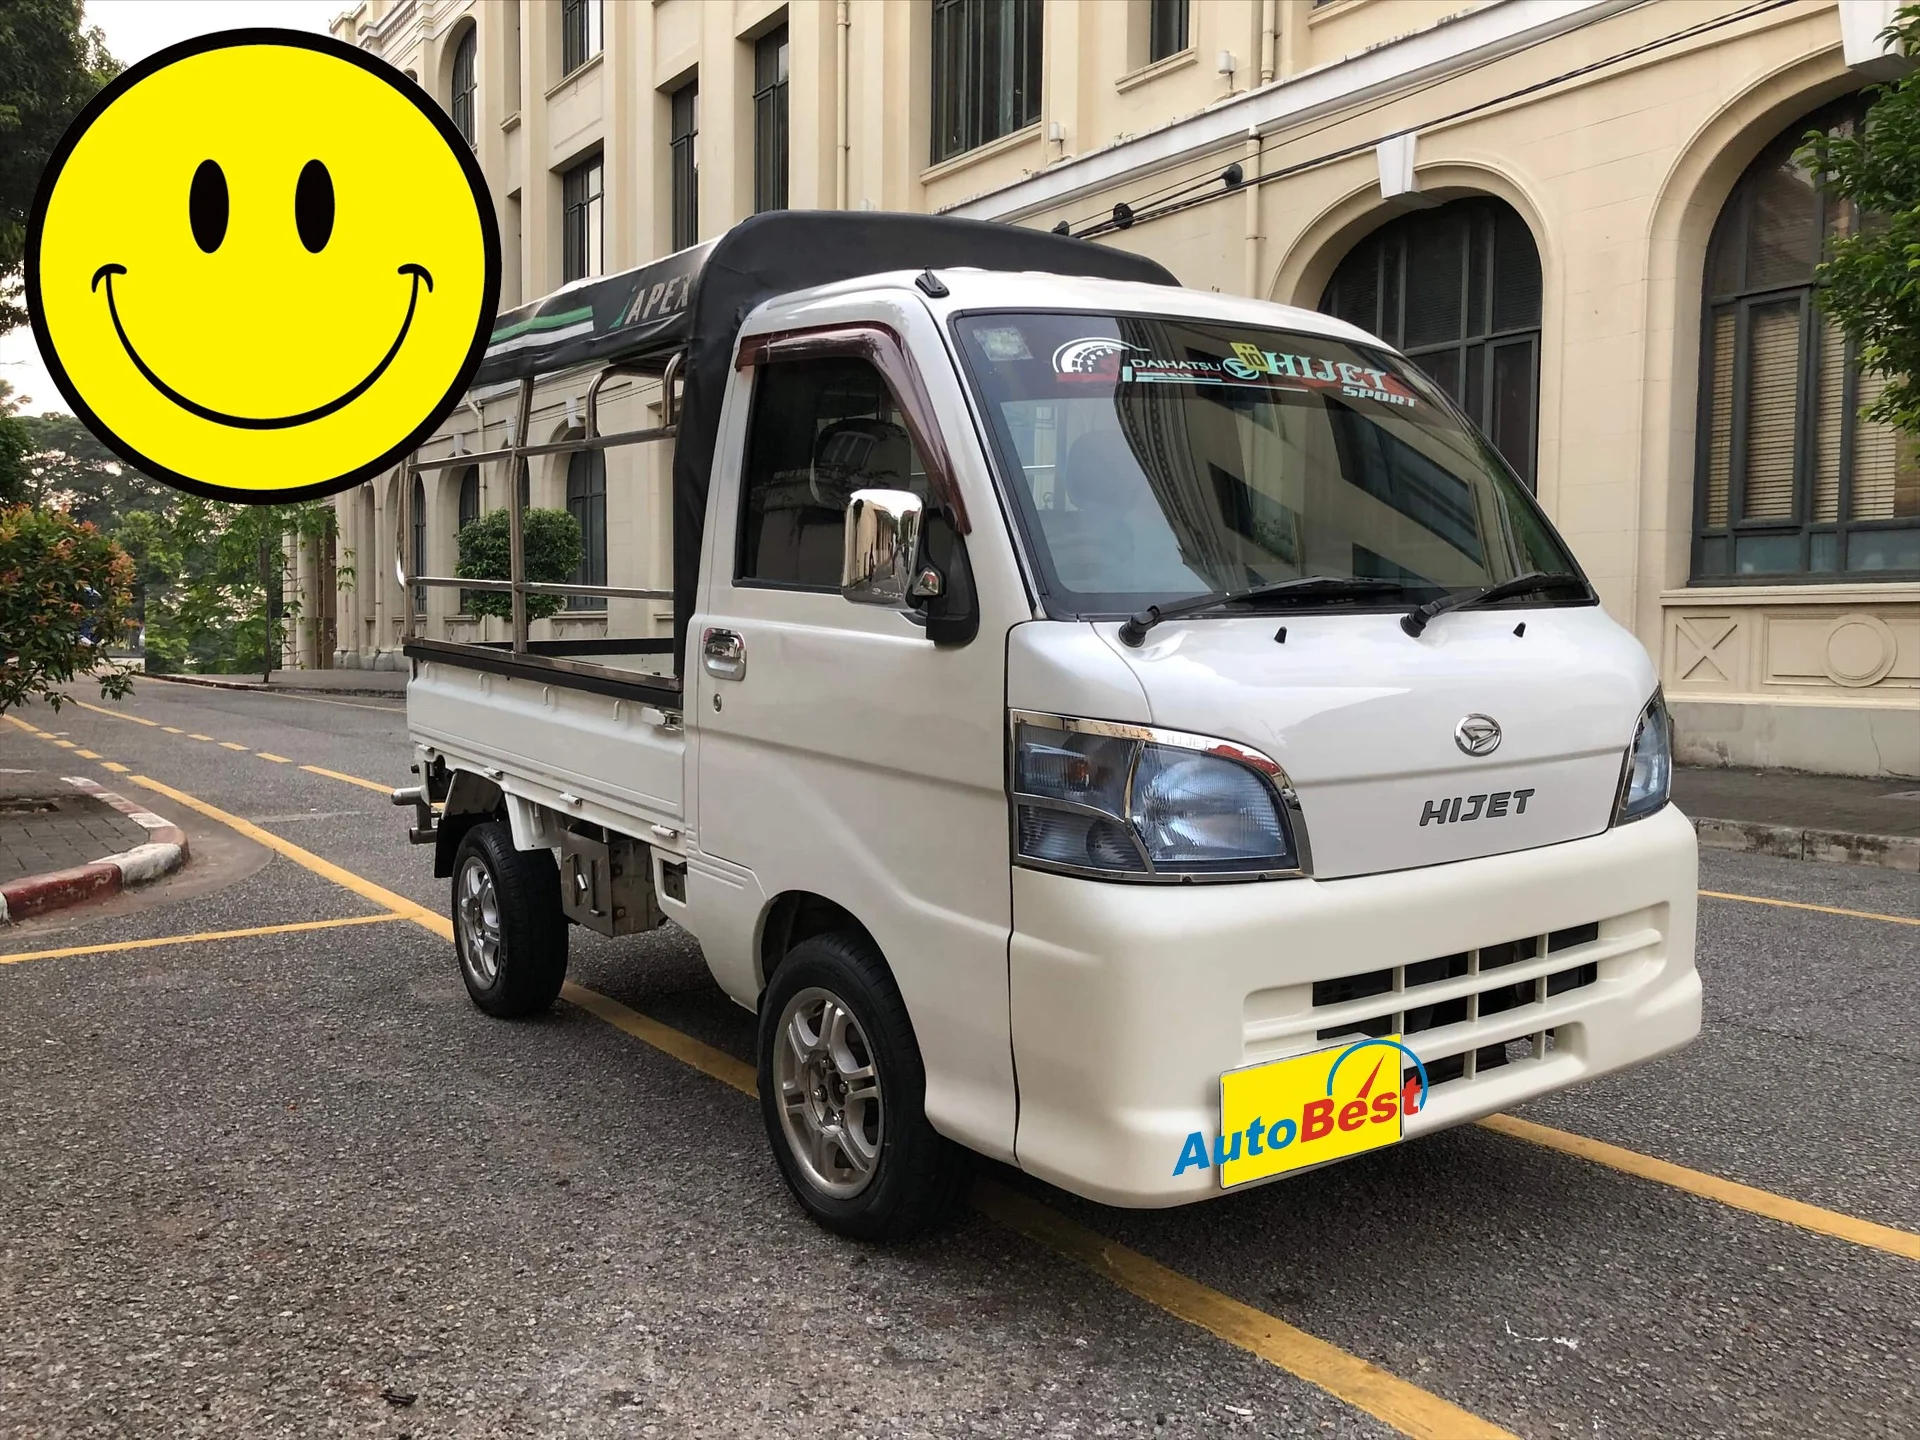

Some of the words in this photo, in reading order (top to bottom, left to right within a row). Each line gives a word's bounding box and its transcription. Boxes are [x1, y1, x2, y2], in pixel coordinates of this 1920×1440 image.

[624, 270, 694, 325] APEX
[1130, 359, 1221, 371] DAIHATSU
[1262, 351, 1387, 391] HIJET
[1342, 386, 1418, 408] SPORT
[1419, 788, 1535, 827] HIJET
